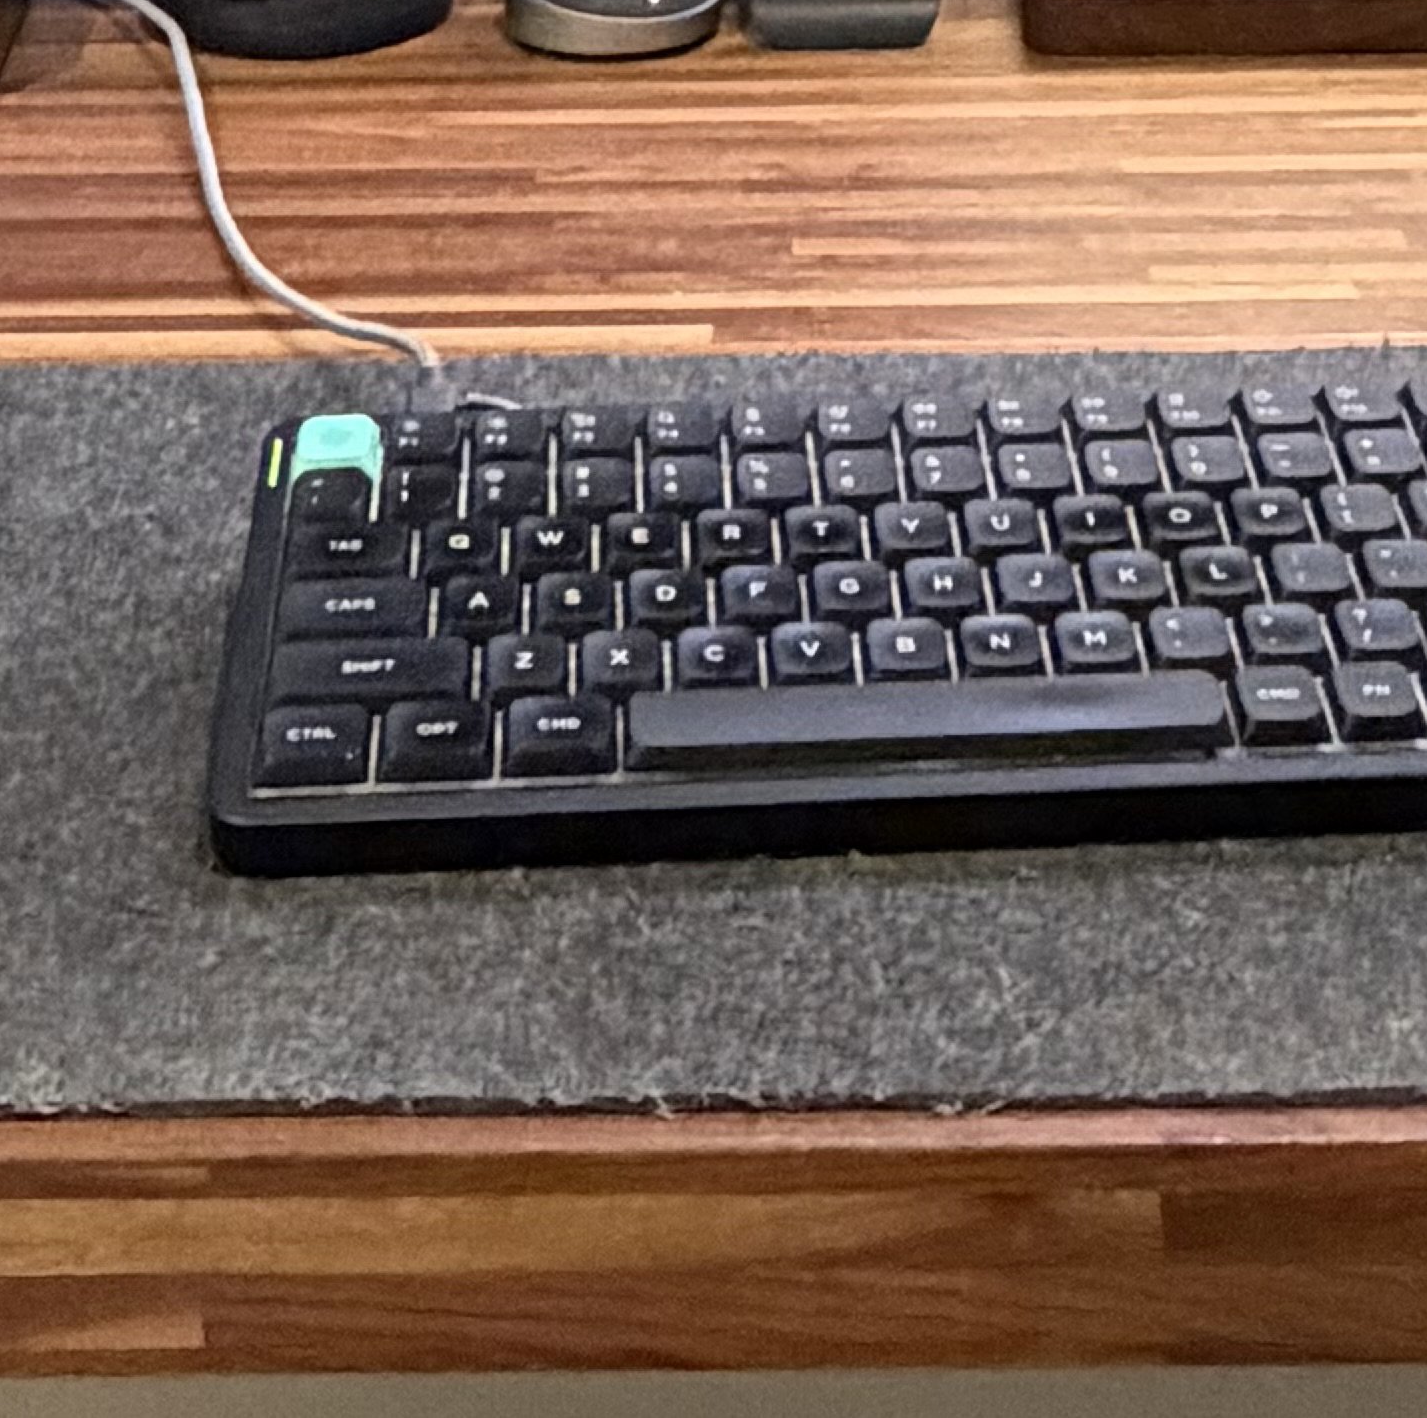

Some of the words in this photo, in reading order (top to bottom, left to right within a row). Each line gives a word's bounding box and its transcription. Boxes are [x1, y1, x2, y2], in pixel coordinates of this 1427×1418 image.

[812, 520, 830, 537] T
[900, 517, 920, 534] Y
[990, 513, 1011, 531] U
[535, 529, 565, 546] W
[1028, 570, 1043, 588] J
[1117, 567, 1138, 584] K
[1208, 562, 1228, 581] L
[932, 573, 954, 592] H
[468, 590, 490, 610] A
[988, 632, 1012, 650] N
[1082, 629, 1108, 646] M
[609, 648, 631, 666] X
[702, 644, 726, 662] C
[799, 639, 821, 659] V
[514, 651, 535, 669] Z
